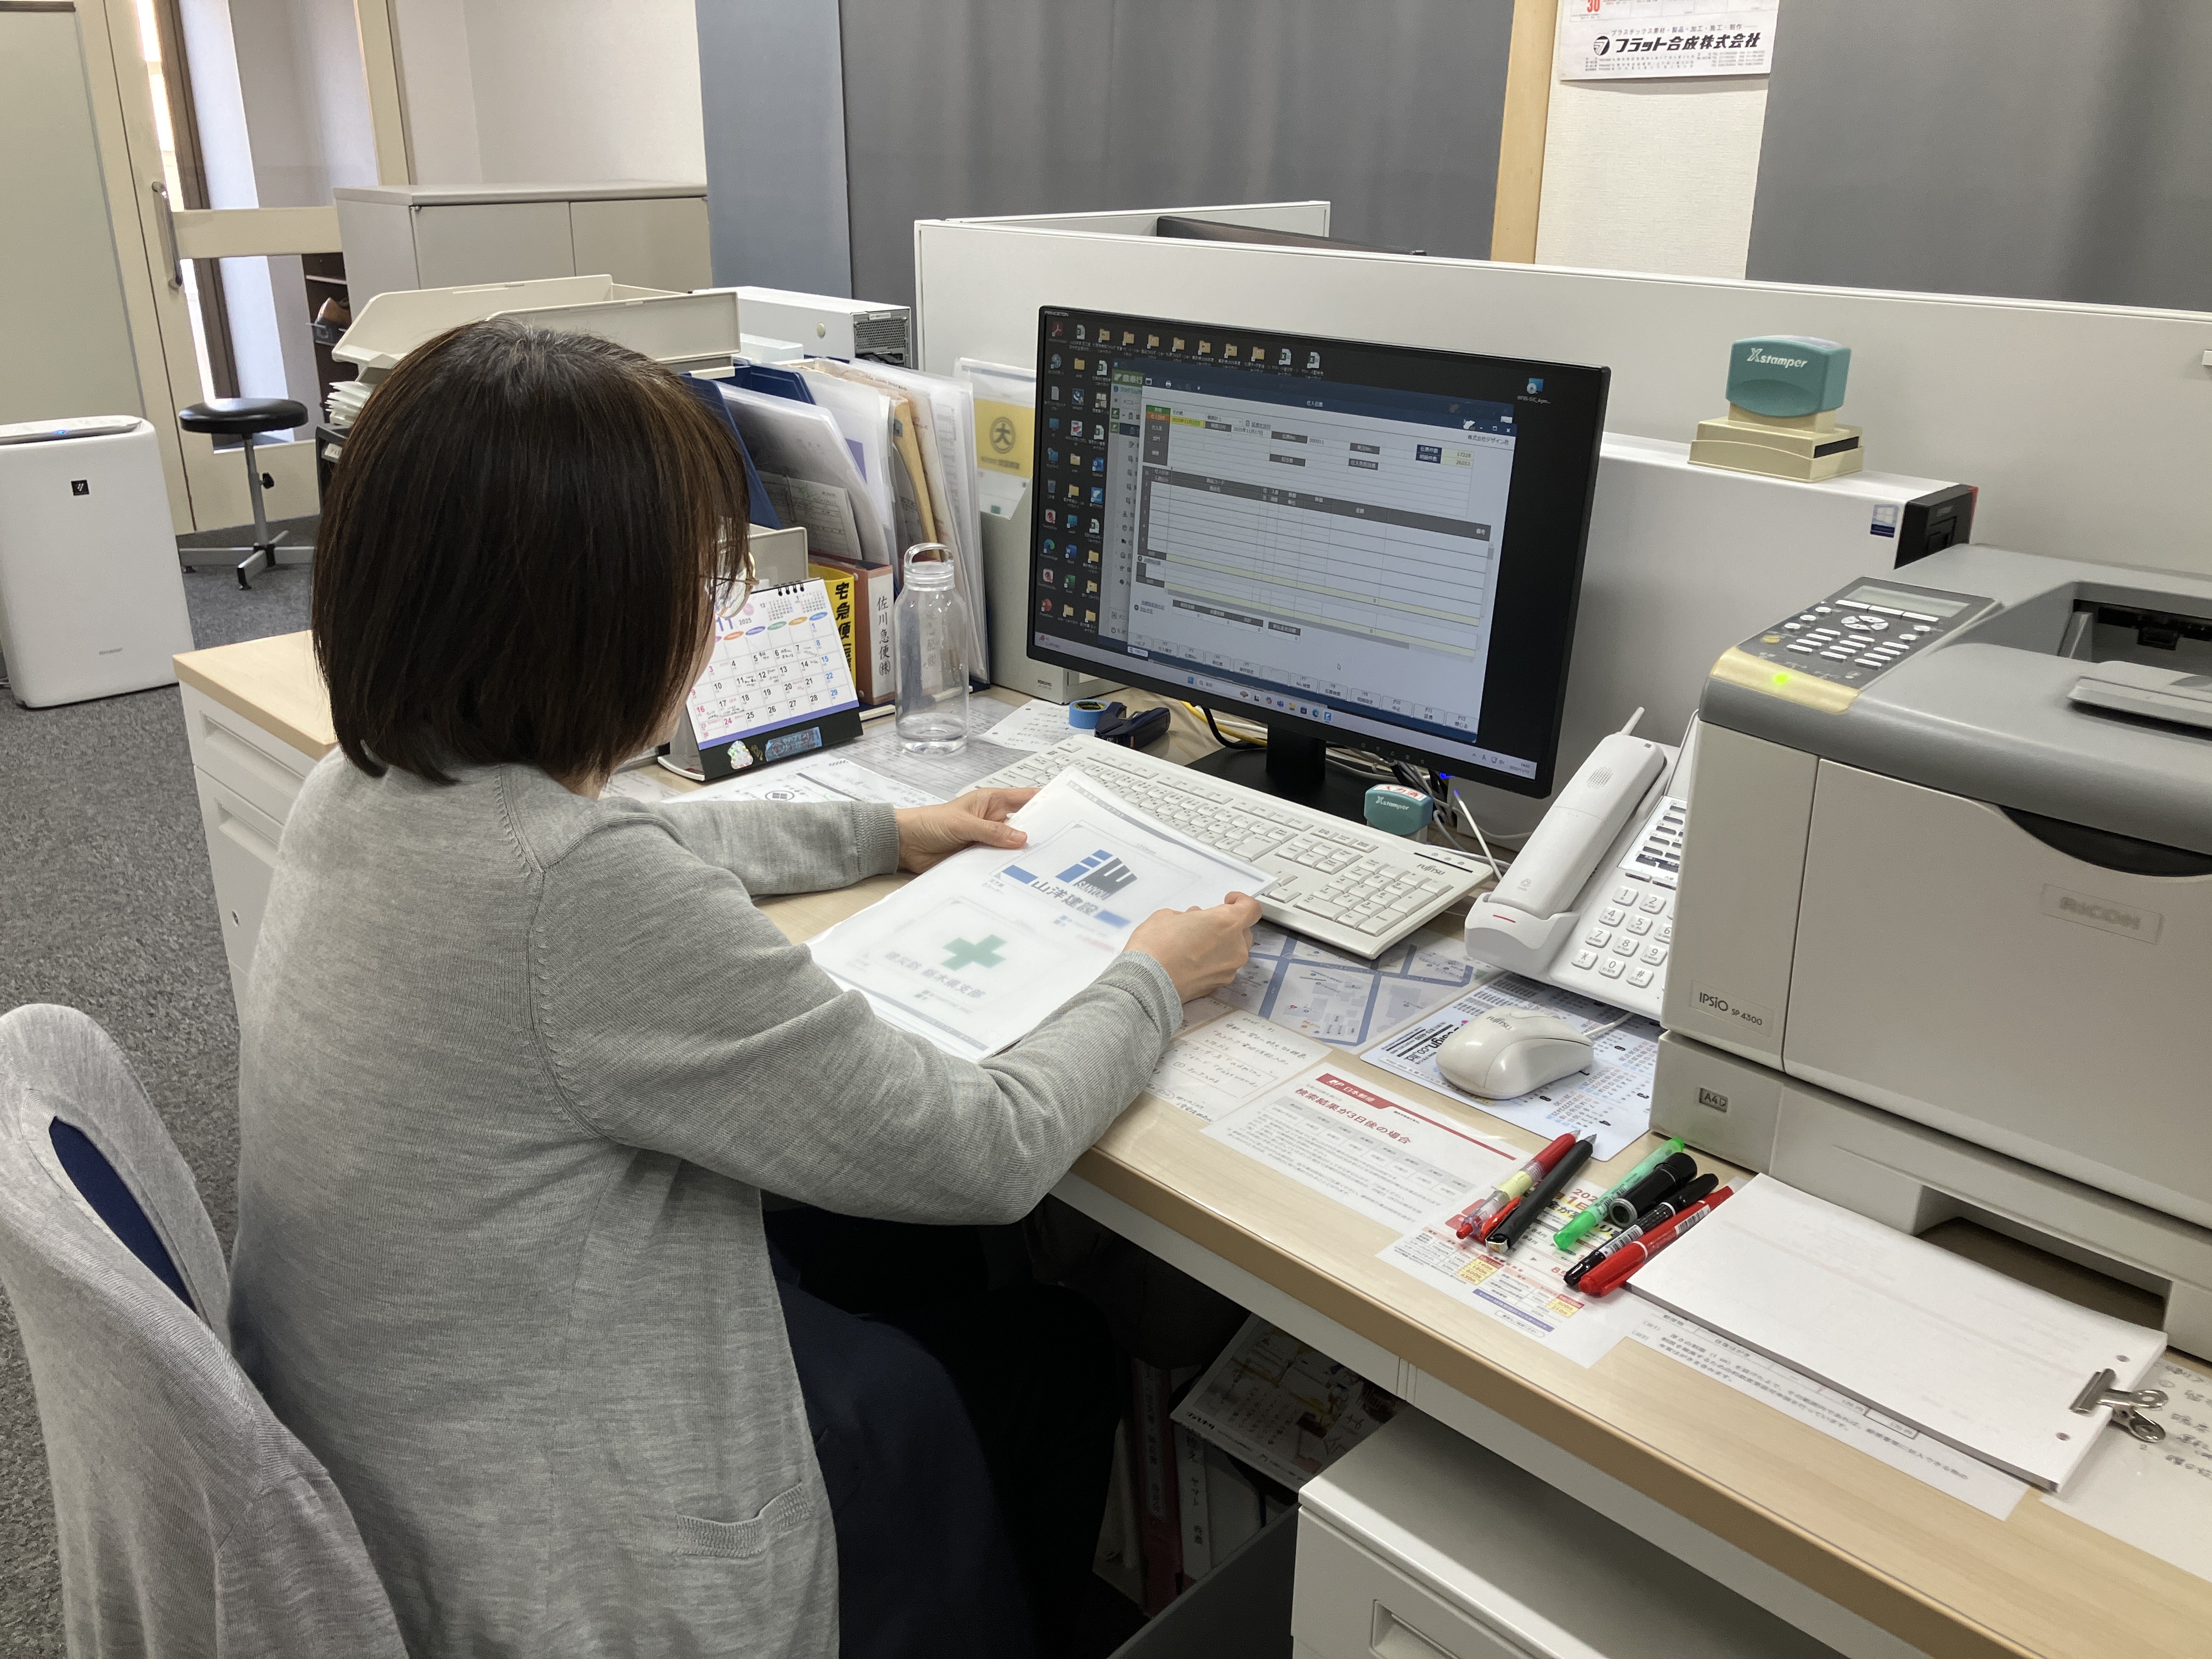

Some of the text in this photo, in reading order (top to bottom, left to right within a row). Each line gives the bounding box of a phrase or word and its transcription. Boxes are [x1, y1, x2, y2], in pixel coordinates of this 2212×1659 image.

[1615, 32, 1761, 53] フラット合成株式会社
[1747, 348, 1808, 369] Xstamper
[1454, 721, 1468, 729] 閉じる
[1375, 795, 1410, 810] Xstamper
[1102, 803, 1125, 818] レイアウト
[1417, 864, 1446, 876] FUJITSU
[1031, 881, 1099, 916] 山洋建設
[1649, 896, 1657, 905] 2
[1608, 910, 1616, 918] 4
[1650, 948, 1658, 956] 9
[1609, 961, 1616, 969] 0
[1637, 970, 1645, 978] #
[922, 968, 986, 998] 栃木県支部
[1486, 1016, 1513, 1030] FUJITSU
[1741, 1013, 1763, 1026] 4300
[1343, 1086, 1376, 1103] 日本郵便
[1704, 1093, 1718, 1104] A4
[1295, 1088, 1411, 1144] 検索結果が3日後の場合
[1452, 1180, 1467, 1188] 日曜日
[1472, 1265, 1487, 1275] 180円
[1551, 1305, 1568, 1315] 210円
[1556, 1301, 1573, 1311] 300円
